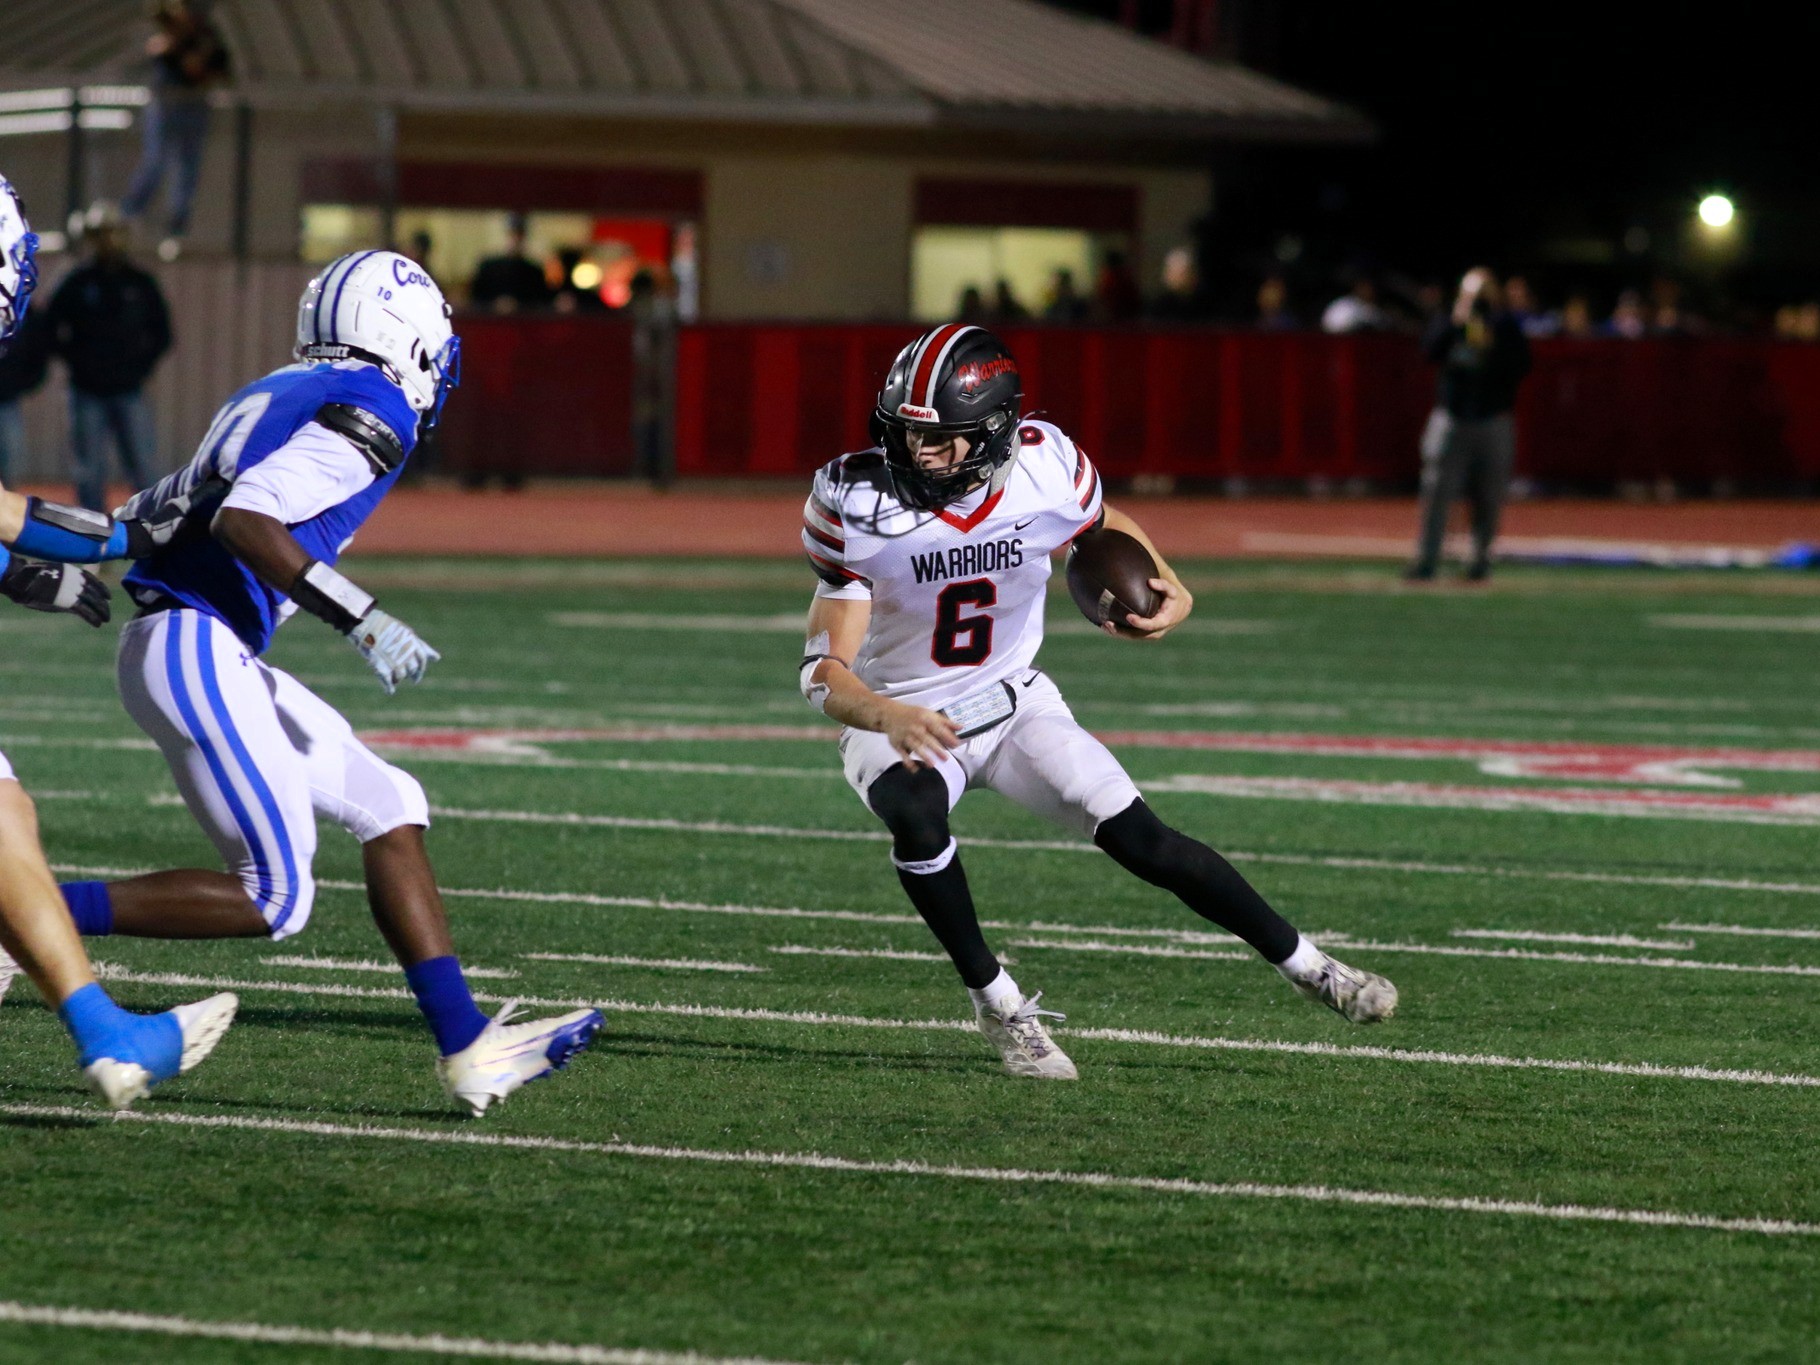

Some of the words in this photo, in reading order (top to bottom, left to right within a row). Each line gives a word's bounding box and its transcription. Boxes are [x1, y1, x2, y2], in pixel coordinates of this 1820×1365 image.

[377, 286, 392, 301] 10
[910, 538, 1023, 584] WARRIORS
[931, 577, 997, 667] 6
